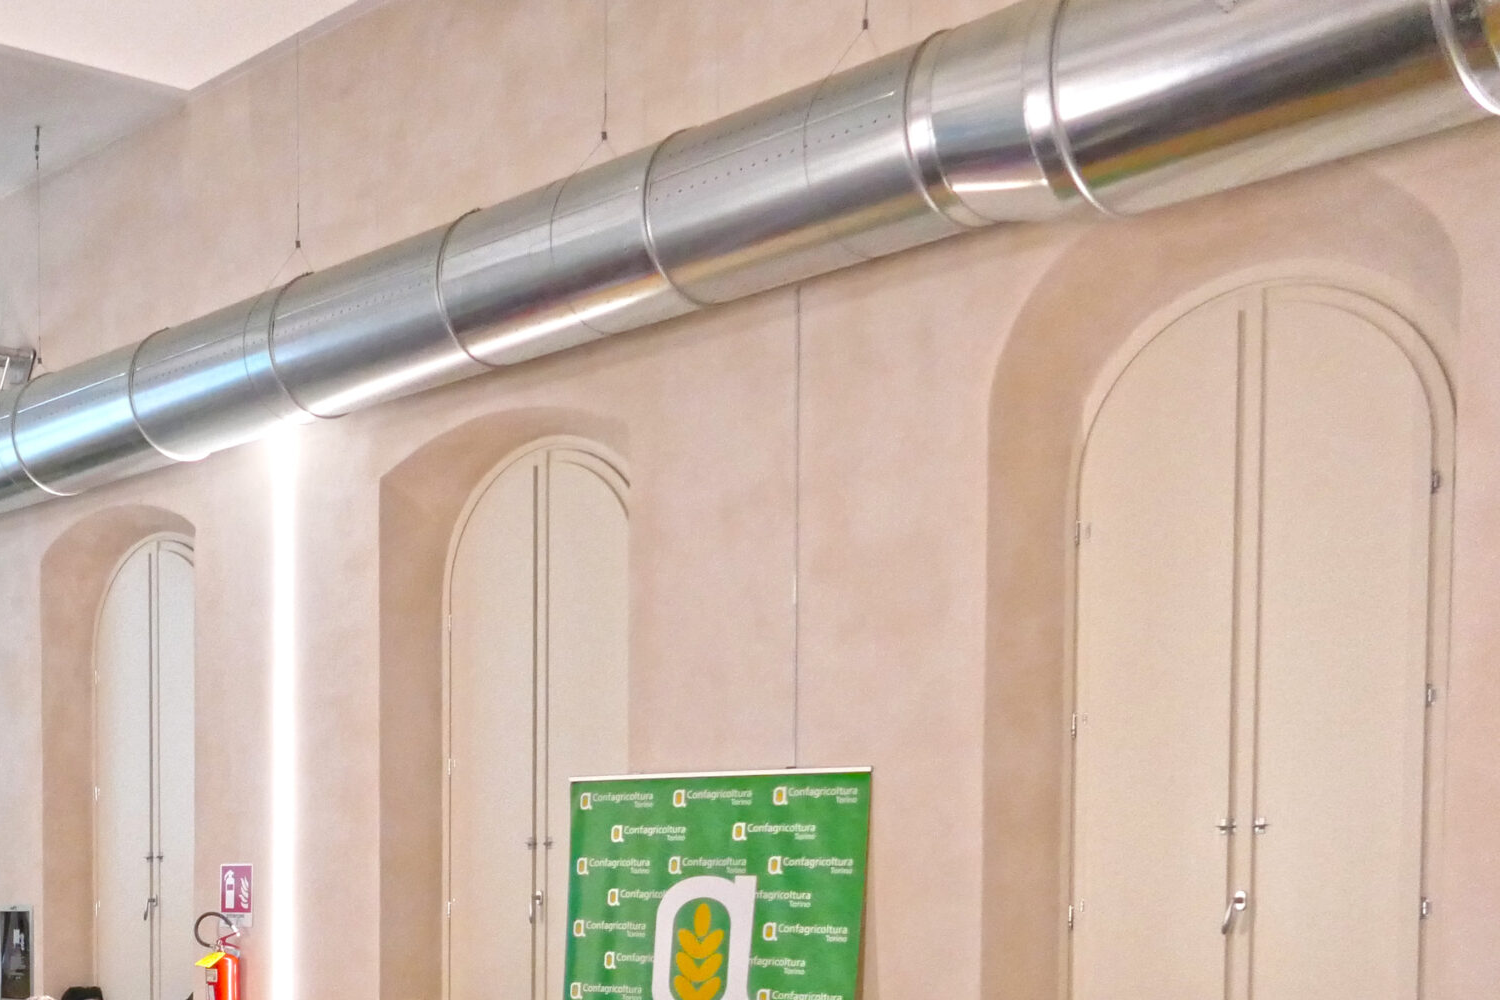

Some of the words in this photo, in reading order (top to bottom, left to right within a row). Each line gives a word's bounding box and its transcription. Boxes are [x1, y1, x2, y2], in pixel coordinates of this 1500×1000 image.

[592, 792, 653, 803] Confagricoltura
[686, 789, 752, 800] Confagricoltura
[787, 786, 858, 798] Confagricoltura
[623, 826, 686, 836] Confagricoltura
[747, 823, 816, 834] Confagricoltura
[588, 858, 650, 868] Confagricoltura
[682, 857, 747, 868] Confagricoltura
[782, 857, 853, 868] Confagricoltura
[586, 921, 646, 931] Confagricoltura
[778, 923, 848, 935] Confagricoltura
[583, 984, 642, 995] Confagricoltura
